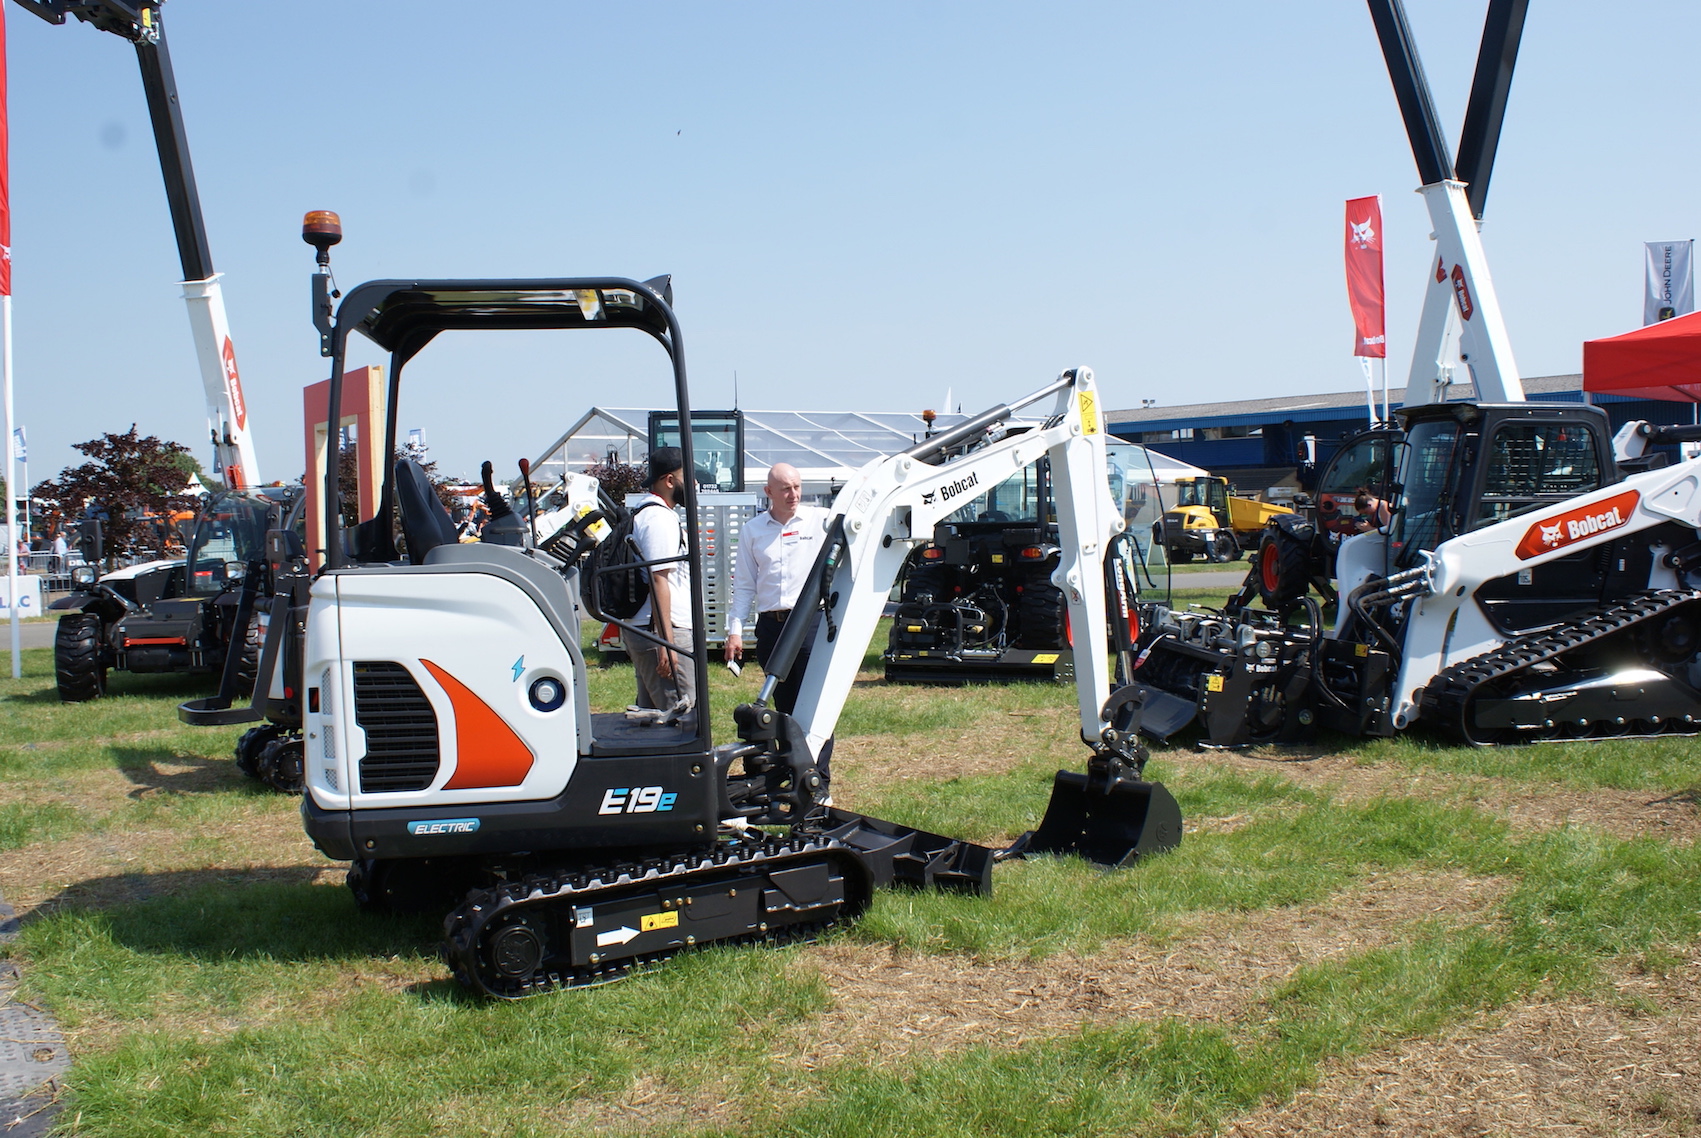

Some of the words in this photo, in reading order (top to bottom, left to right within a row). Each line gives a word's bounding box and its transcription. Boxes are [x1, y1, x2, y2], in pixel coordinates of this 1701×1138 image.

[1663, 246, 1672, 277] DEERE
[1457, 290, 1469, 312] Bobcat
[1663, 279, 1672, 304] JOHN
[230, 378, 243, 419] Bobcat
[940, 471, 979, 501] Bobcat
[1567, 506, 1622, 540] Bobcat
[598, 786, 678, 815] E19e
[414, 821, 477, 835] ELECTRIC
